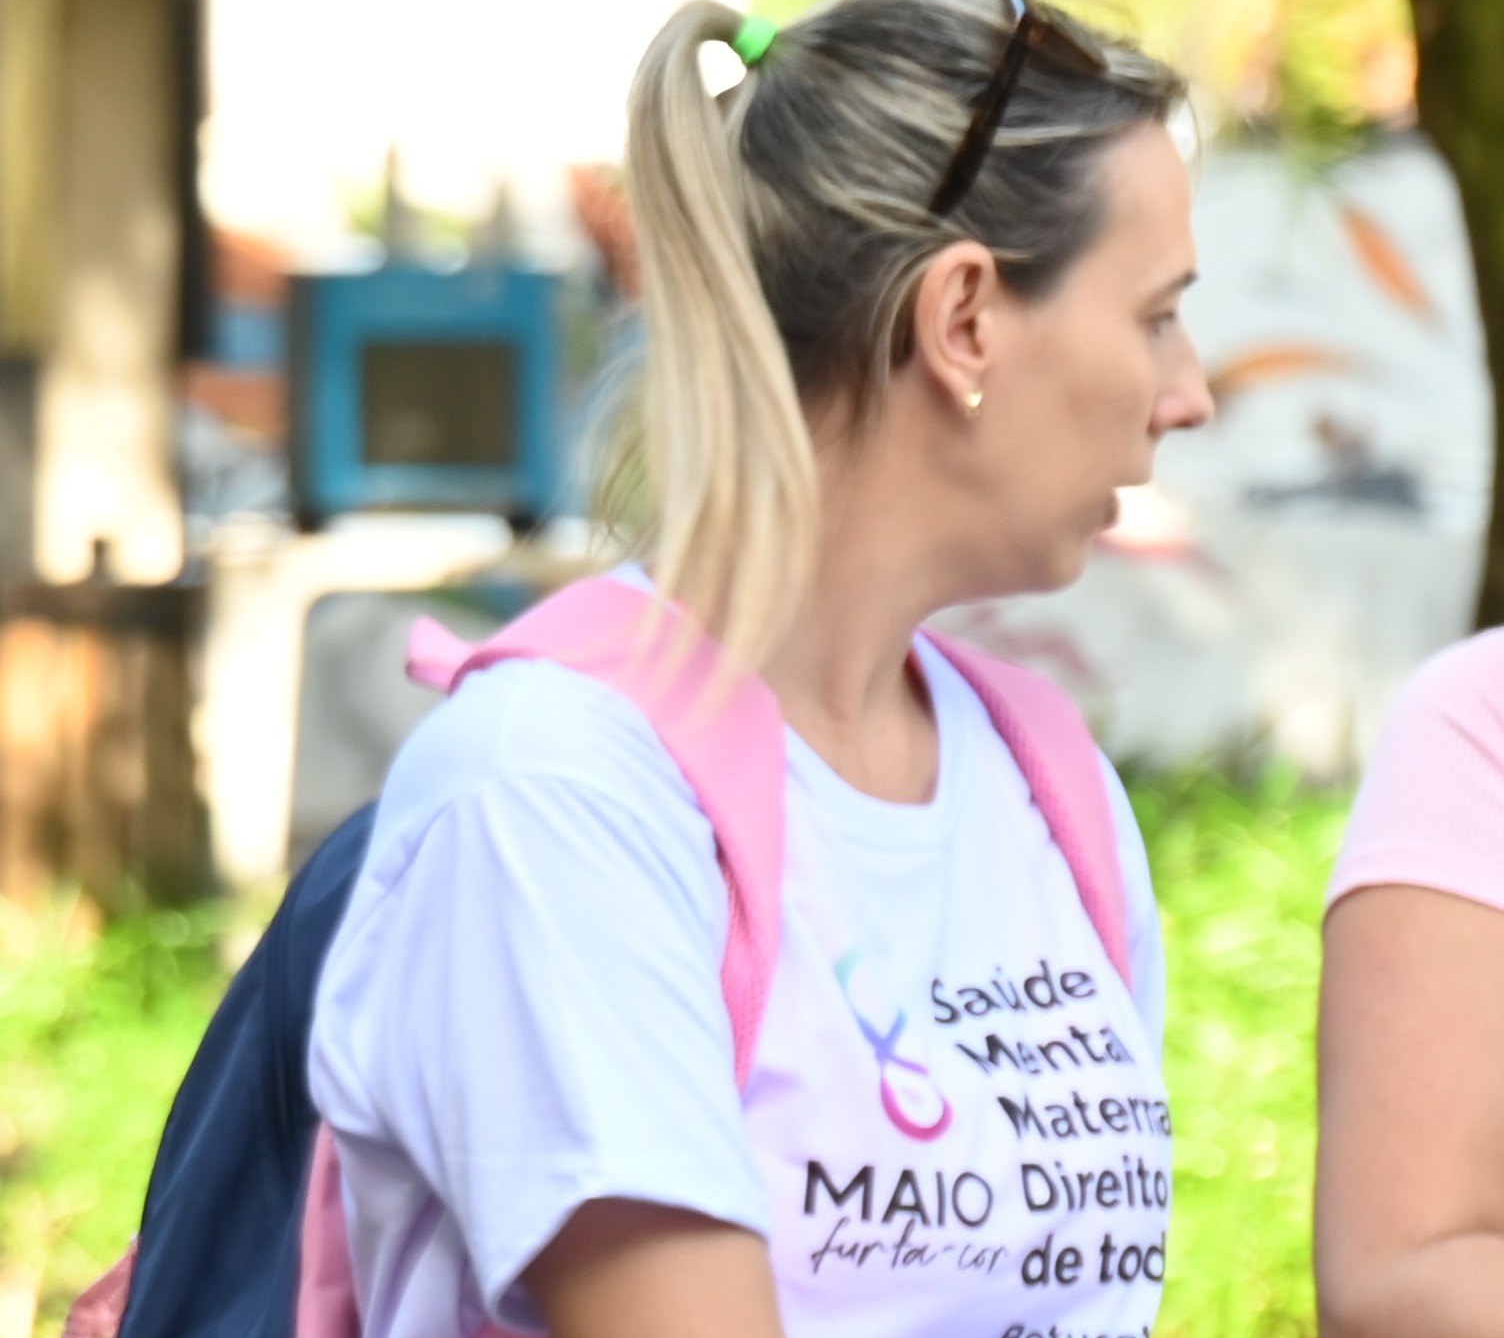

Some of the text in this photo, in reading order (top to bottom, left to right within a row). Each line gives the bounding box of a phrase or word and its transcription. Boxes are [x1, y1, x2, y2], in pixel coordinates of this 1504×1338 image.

[800, 1156, 995, 1228] MAIO
[1019, 1153, 1169, 1215] Direito
[1019, 1230, 1085, 1289] de
